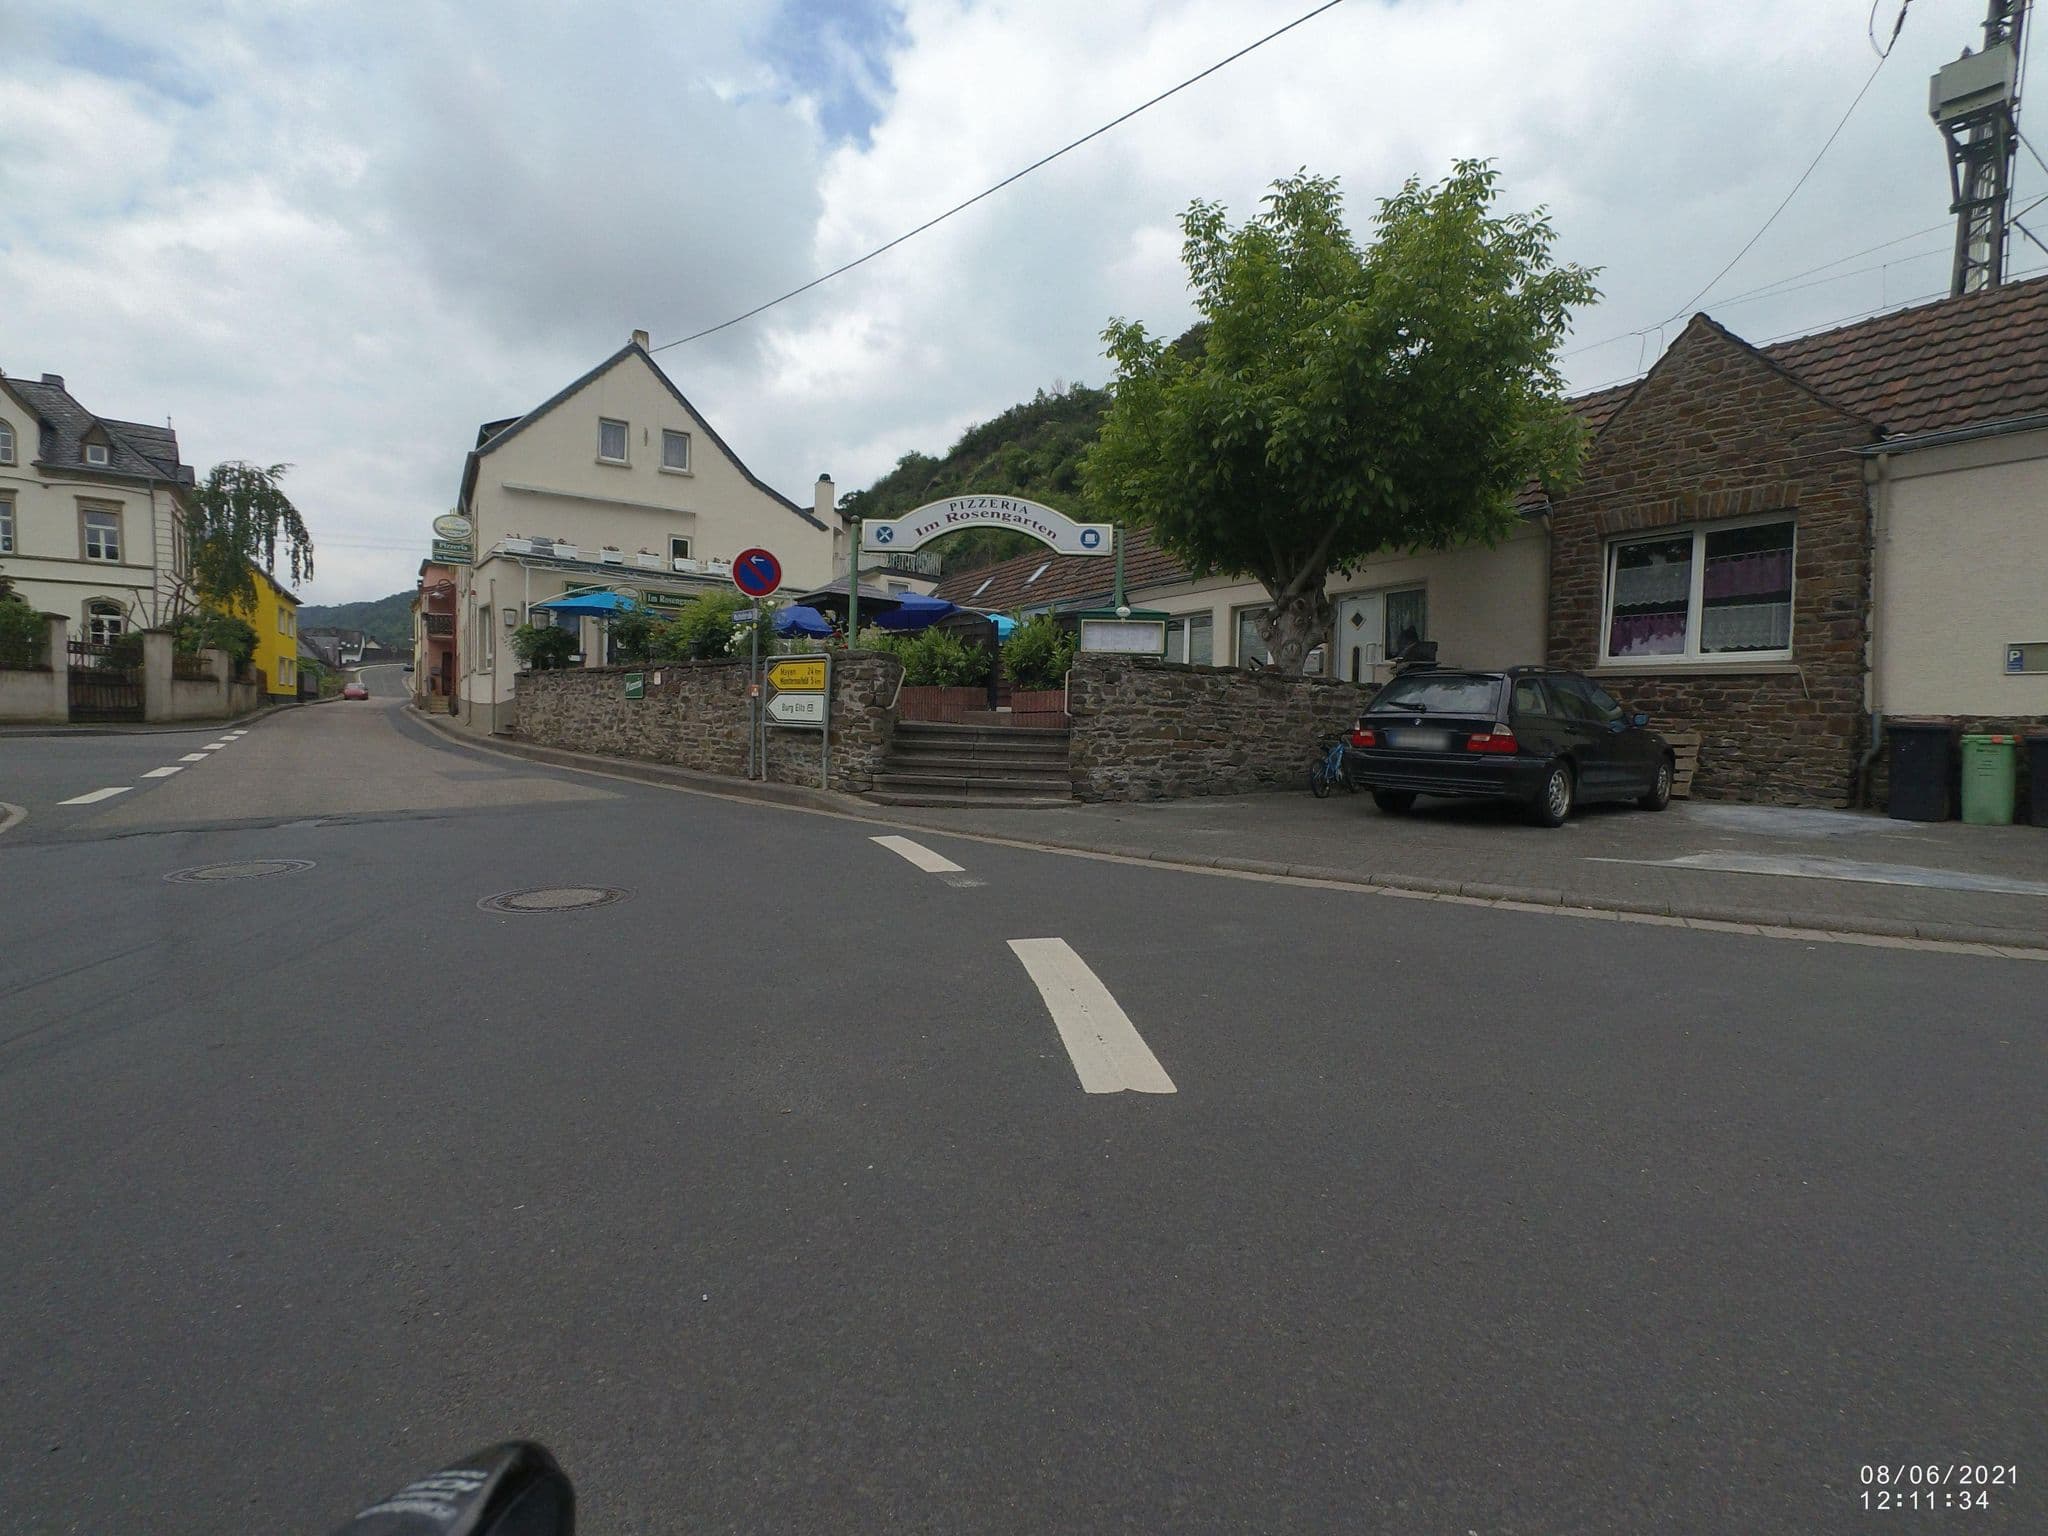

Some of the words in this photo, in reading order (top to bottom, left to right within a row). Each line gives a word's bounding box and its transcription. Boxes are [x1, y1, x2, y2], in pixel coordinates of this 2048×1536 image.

[949, 498, 1029, 515] PIZZERIA
[914, 521, 940, 537] Im
[945, 509, 1058, 540] Rosengarten
[647, 593, 658, 603] Im
[2009, 651, 2020, 662] P
[780, 667, 796, 678] Mayen
[807, 666, 814, 675] 24
[781, 703, 794, 713] Burg
